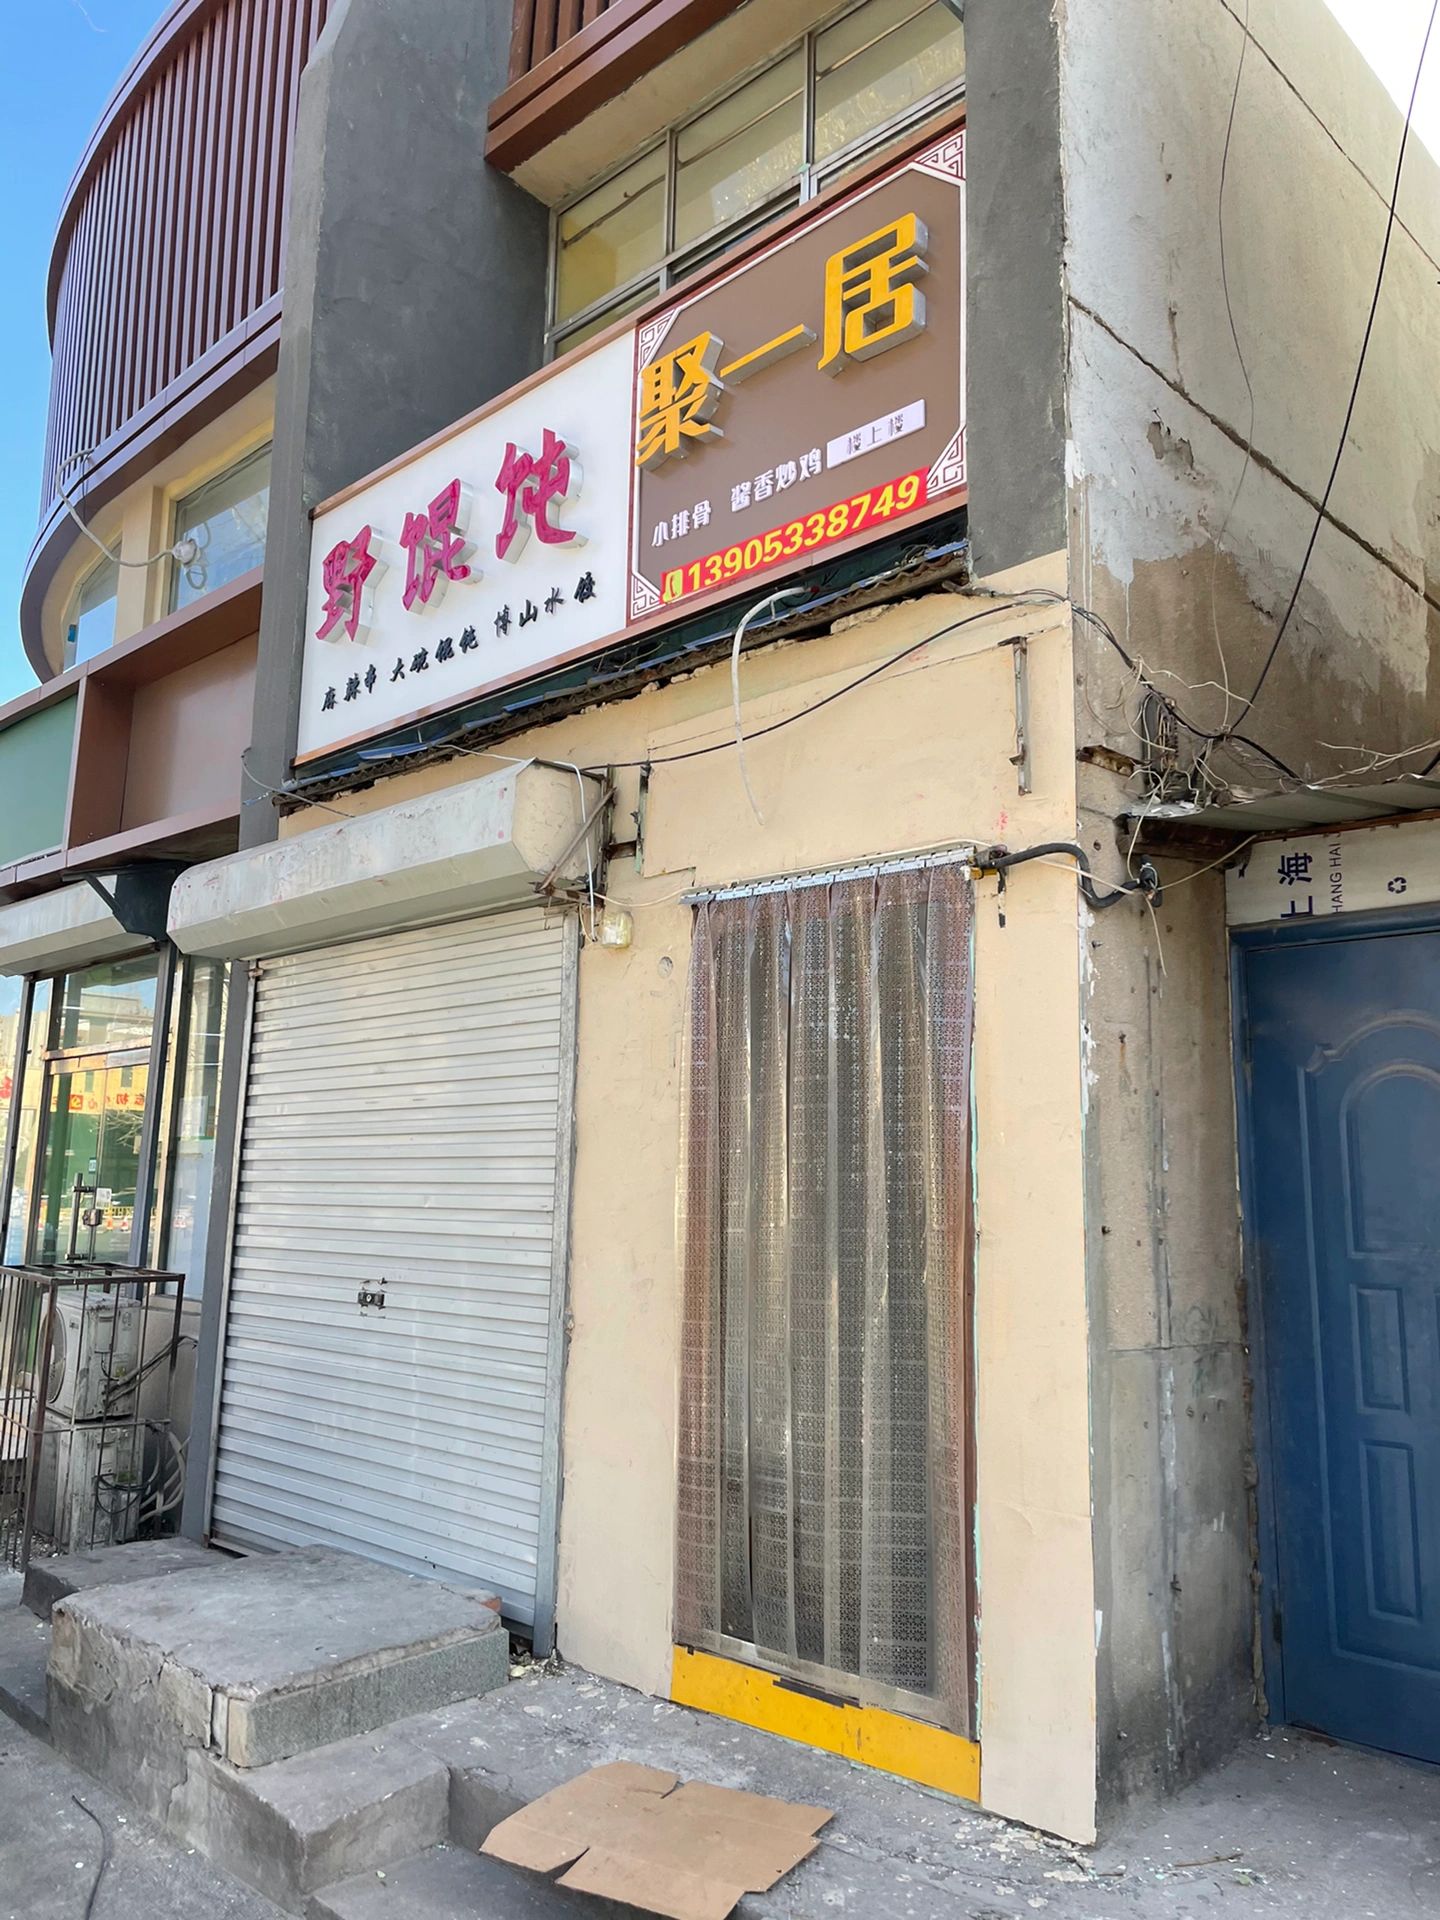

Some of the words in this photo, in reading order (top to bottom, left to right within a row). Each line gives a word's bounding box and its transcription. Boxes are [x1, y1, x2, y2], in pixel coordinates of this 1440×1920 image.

[634, 211, 918, 470] 聚一居
[847, 412, 905, 455] 楼上楼
[316, 427, 584, 642] 野馄饨
[651, 499, 712, 547] 小排骨
[730, 447, 823, 512] 酱香炒鸡
[687, 474, 920, 592] 13905338749
[321, 663, 378, 712] 麻辣串
[390, 625, 480, 682] 大碗馄饨
[494, 571, 597, 638] 博山水饺
[1277, 852, 1314, 918] 上海
[1329, 843, 1342, 867] HAI
